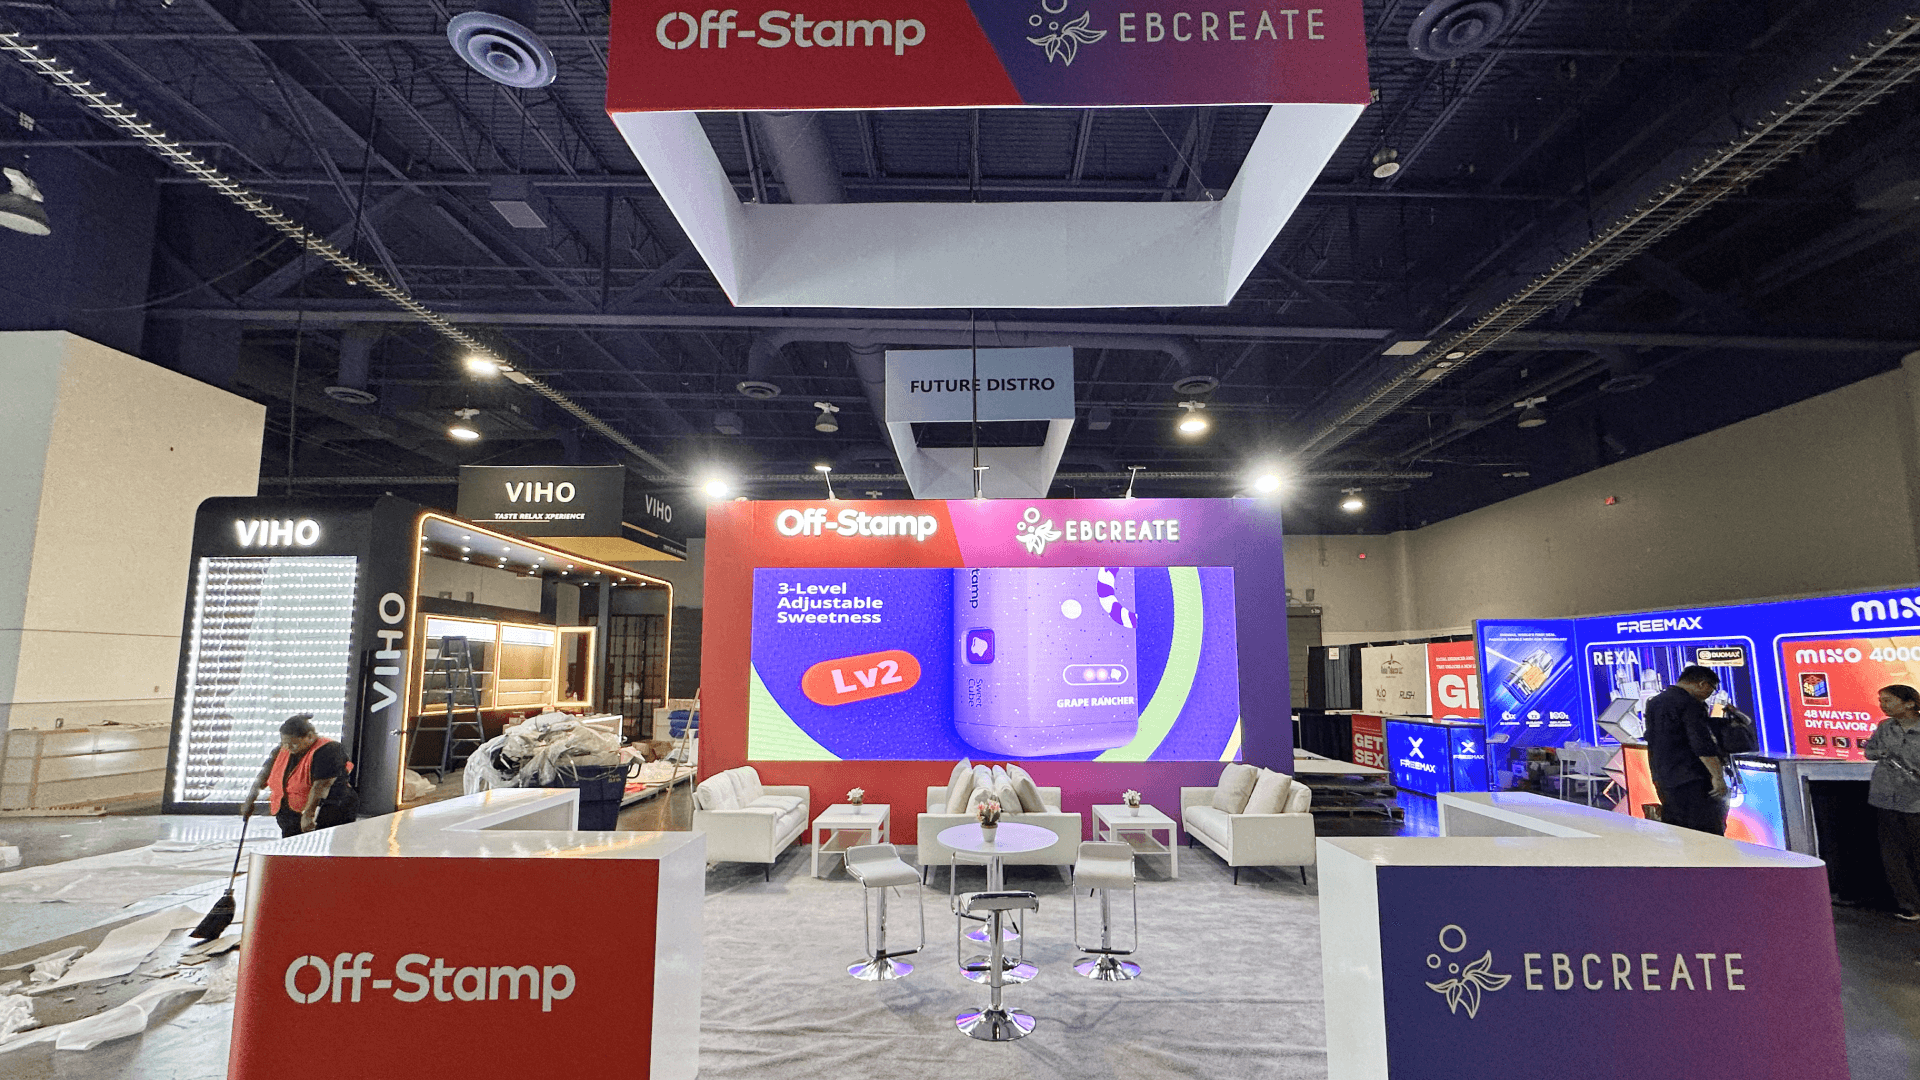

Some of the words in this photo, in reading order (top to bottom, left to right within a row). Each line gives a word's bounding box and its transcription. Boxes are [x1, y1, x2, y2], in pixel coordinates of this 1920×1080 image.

[656, 9, 926, 55] Off-Stamp
[1120, 9, 1325, 42] EBCREATE
[910, 380, 981, 394] FUTURE
[987, 378, 1055, 393] DISTRO
[505, 481, 576, 503] VIHO
[645, 494, 672, 523] VIHO
[235, 518, 320, 547] VIHO
[776, 508, 938, 541] Off-Stamp
[1065, 518, 1180, 542] EBCREATE
[778, 582, 847, 594] 3-Level
[777, 597, 883, 611] Adjustable
[777, 611, 881, 623] Sweetness
[1616, 616, 1703, 634] FREEMAX
[370, 591, 406, 713] VIHO
[1593, 651, 1638, 665] REXA
[831, 659, 902, 694] Lv2
[968, 678, 976, 707] Cube
[1057, 698, 1089, 708] GRAPE
[1091, 696, 1135, 707] RANCHER
[1804, 710, 1818, 718] 48
[1819, 710, 1853, 720] WAYS
[1853, 712, 1871, 720] TO
[1805, 720, 1822, 728] DIY
[1823, 721, 1868, 731] FLAVOR
[1354, 733, 1384, 750] GET
[1354, 749, 1385, 768] SEX
[1400, 758, 1436, 773] FREEMAX
[285, 951, 576, 1013] Off-Stamp
[1524, 953, 1746, 991] EBCREATE
